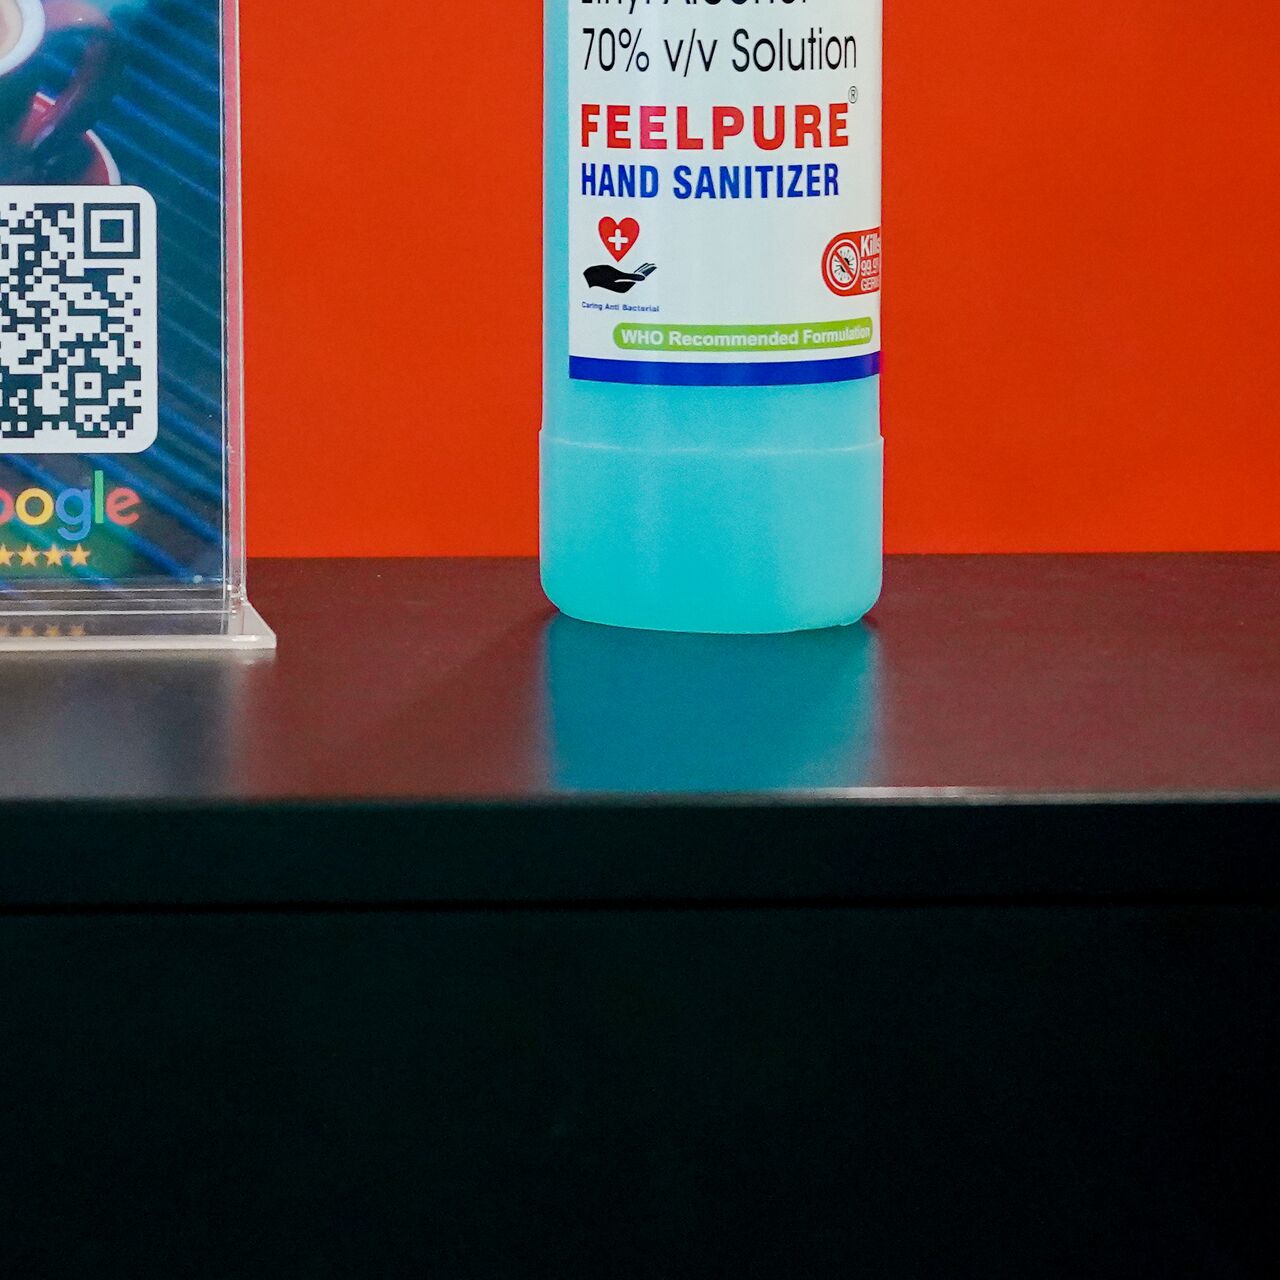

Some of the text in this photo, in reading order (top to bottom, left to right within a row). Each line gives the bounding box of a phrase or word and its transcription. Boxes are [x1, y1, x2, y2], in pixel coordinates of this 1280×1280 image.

[582, 27, 857, 77] 70% v/v Solution
[581, 163, 840, 200] HAND SANITIZER
[621, 325, 871, 346] WHO Recommended Formulation
